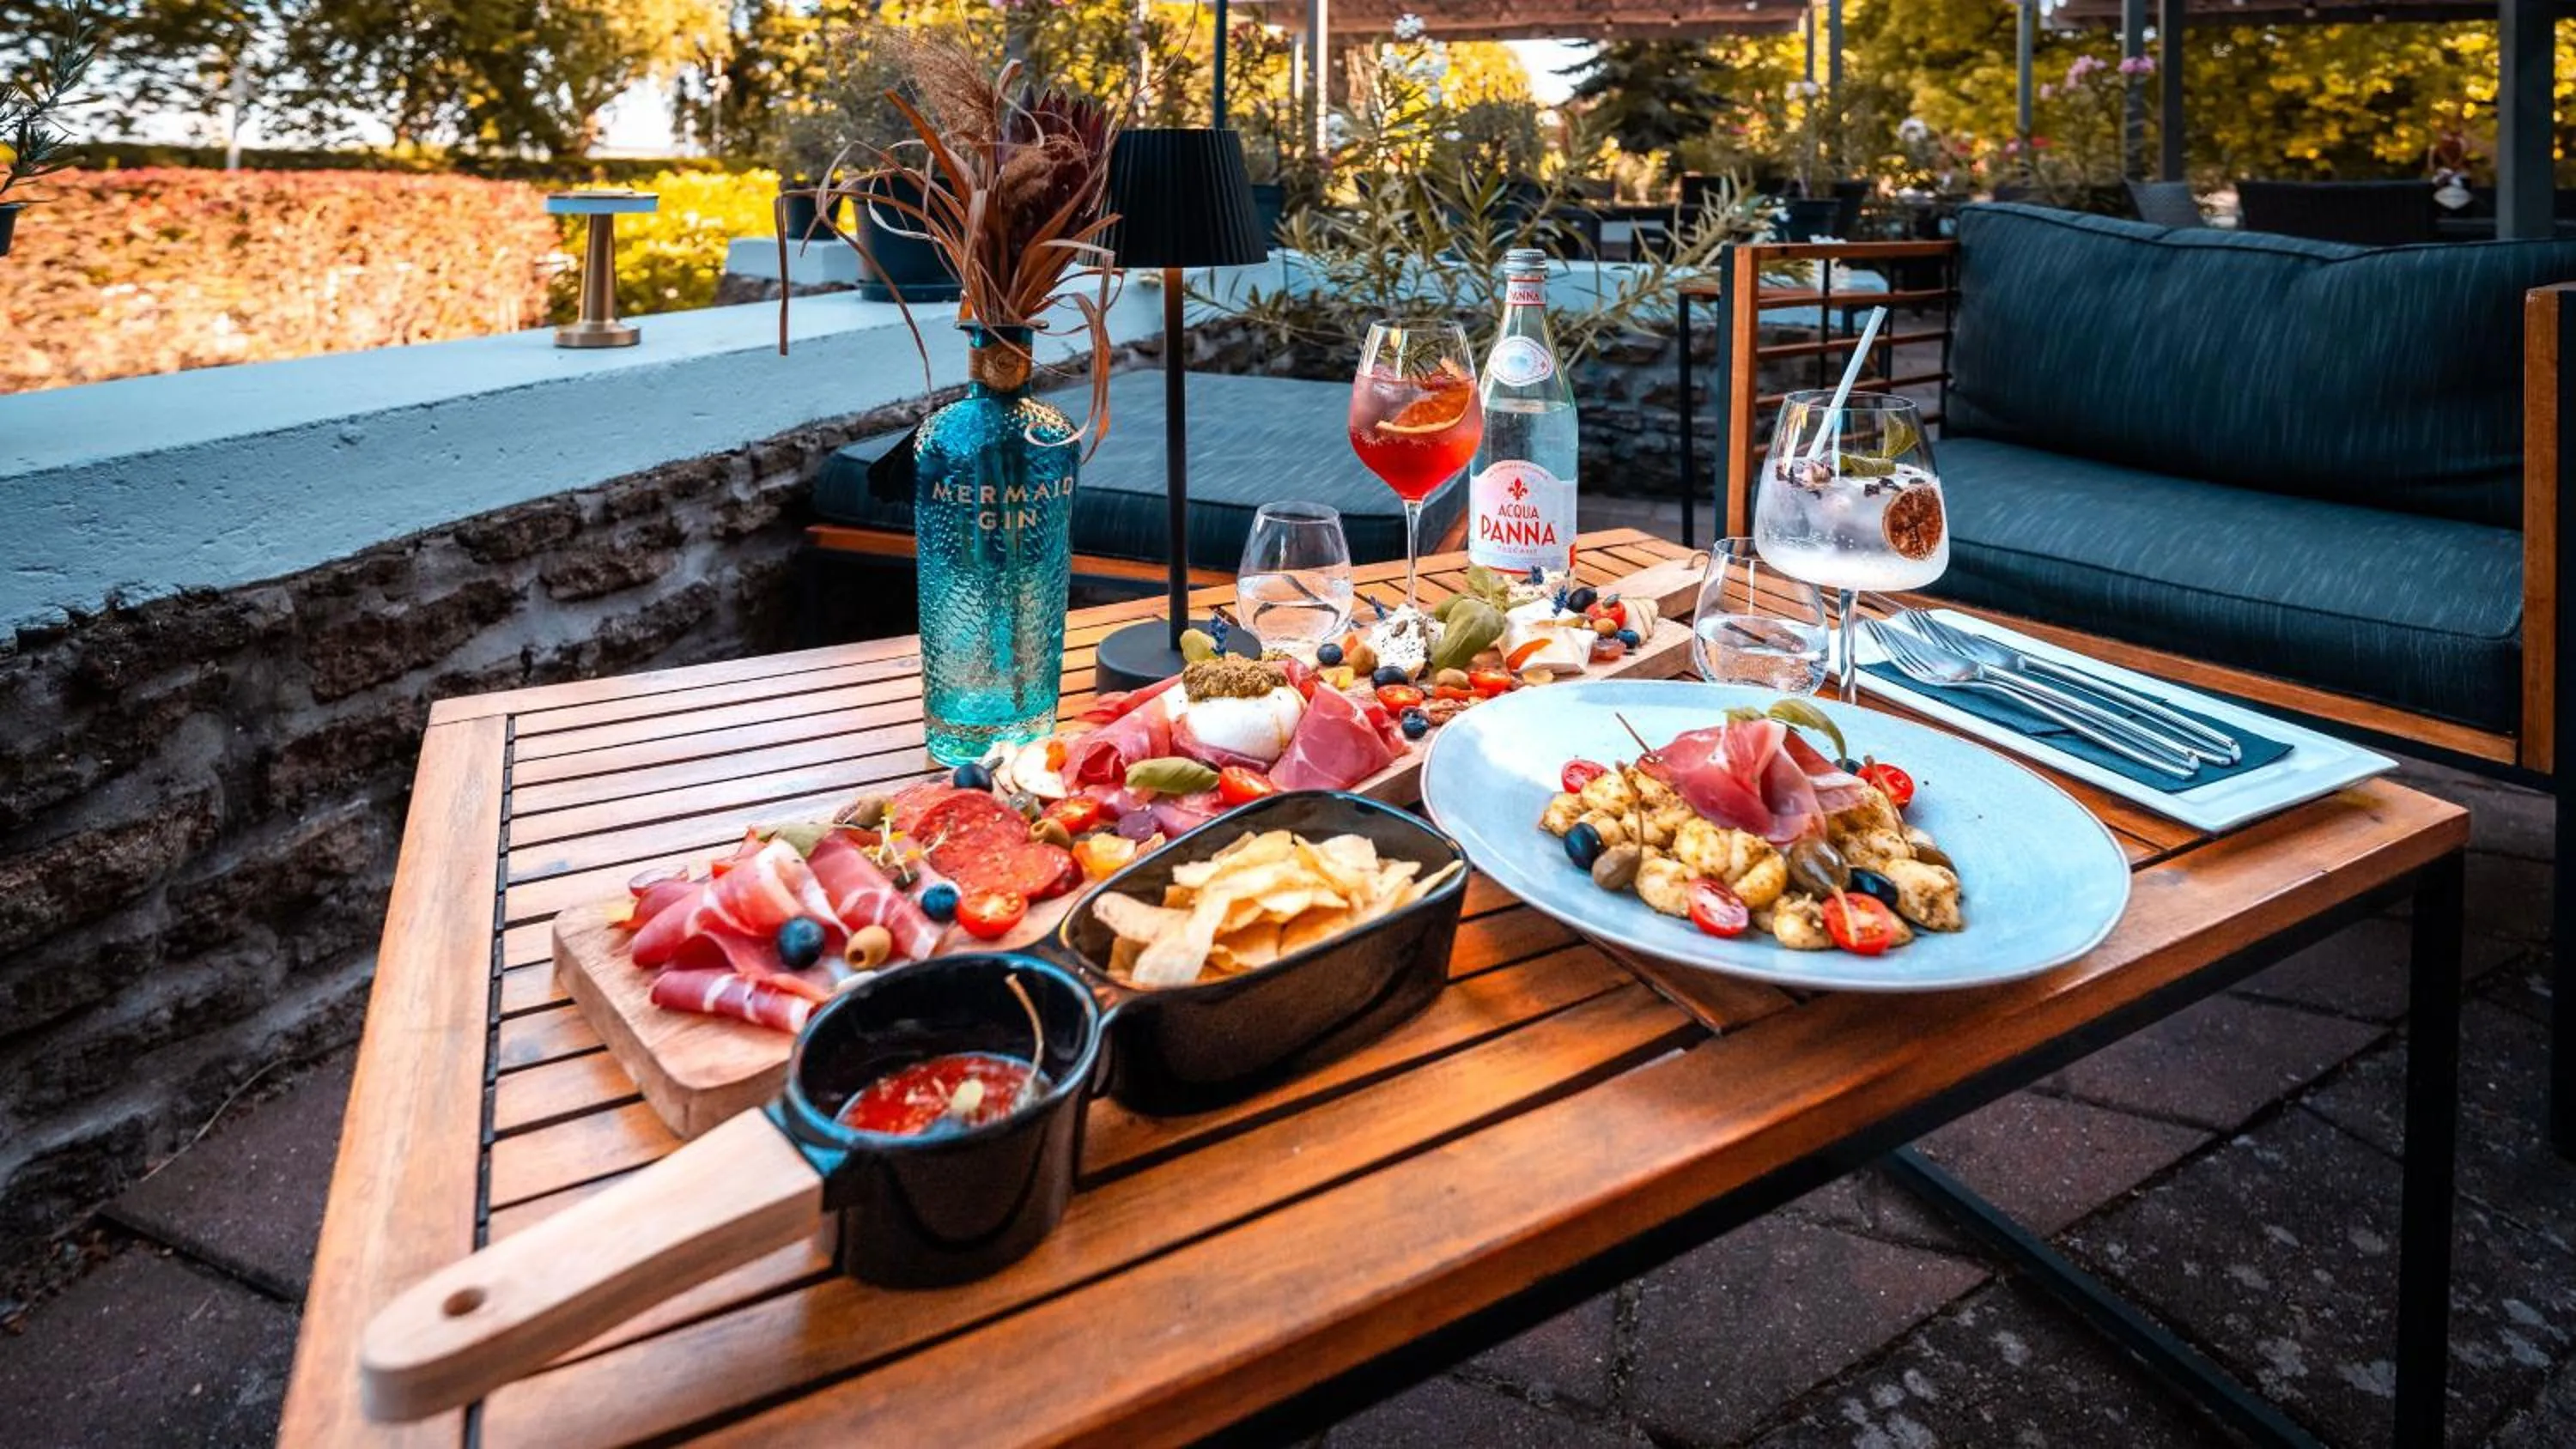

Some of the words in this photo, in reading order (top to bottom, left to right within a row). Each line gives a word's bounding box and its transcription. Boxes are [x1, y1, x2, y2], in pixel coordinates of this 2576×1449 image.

[932, 476, 1073, 503] MERMAID
[978, 510, 1037, 530] GIN
[1498, 504, 1540, 519] ACQUA
[1481, 513, 1556, 547] PANNA
